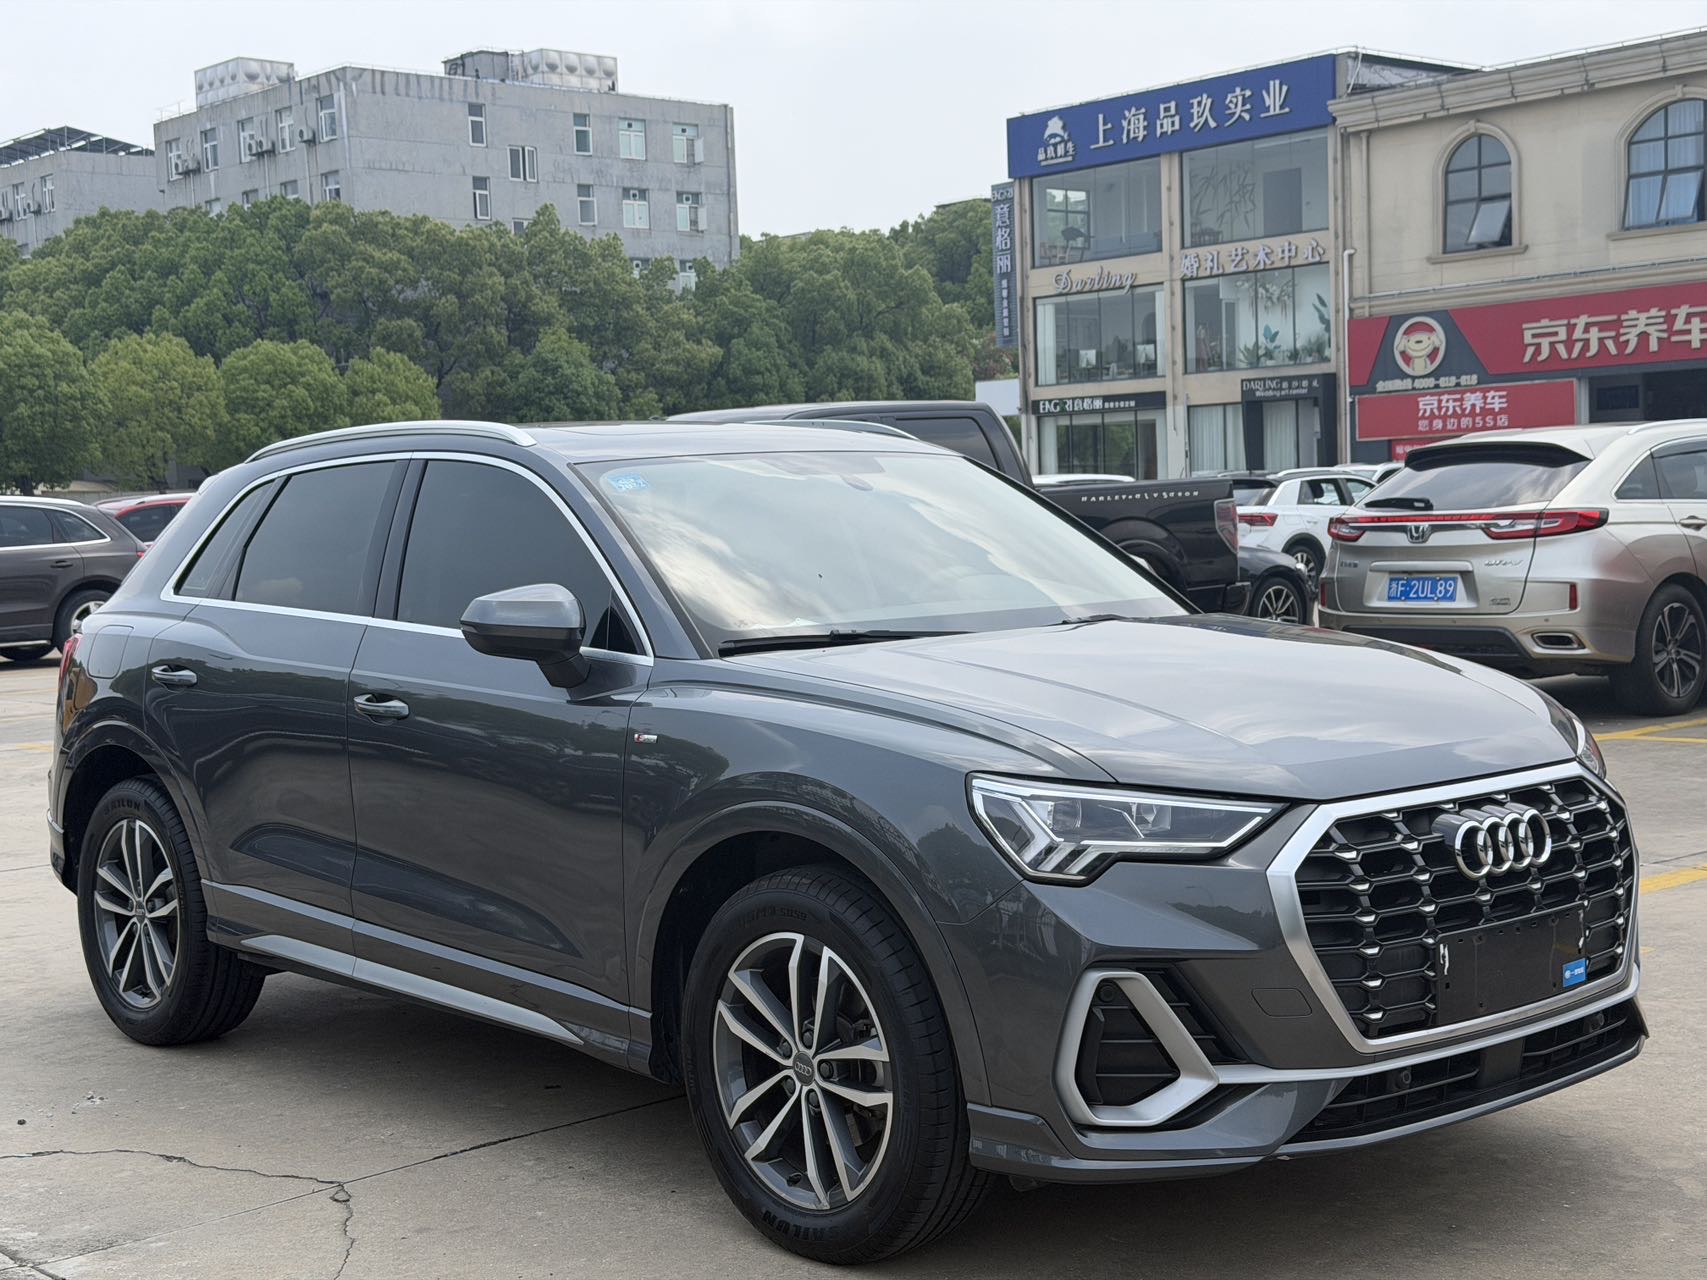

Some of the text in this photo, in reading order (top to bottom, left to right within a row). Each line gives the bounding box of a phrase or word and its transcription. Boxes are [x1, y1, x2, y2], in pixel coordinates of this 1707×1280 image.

[1089, 79, 1291, 150] 上海品玖实业
[995, 204, 1011, 274] 意格丽
[1180, 239, 1326, 279] 婚礼艺术中心
[1053, 265, 1137, 295] Darling
[1522, 304, 1707, 363] 京东养车
[1242, 378, 1280, 391] DARLING
[1417, 390, 1508, 417] 京东养车
[1418, 415, 1509, 431] 您身边的5S店
